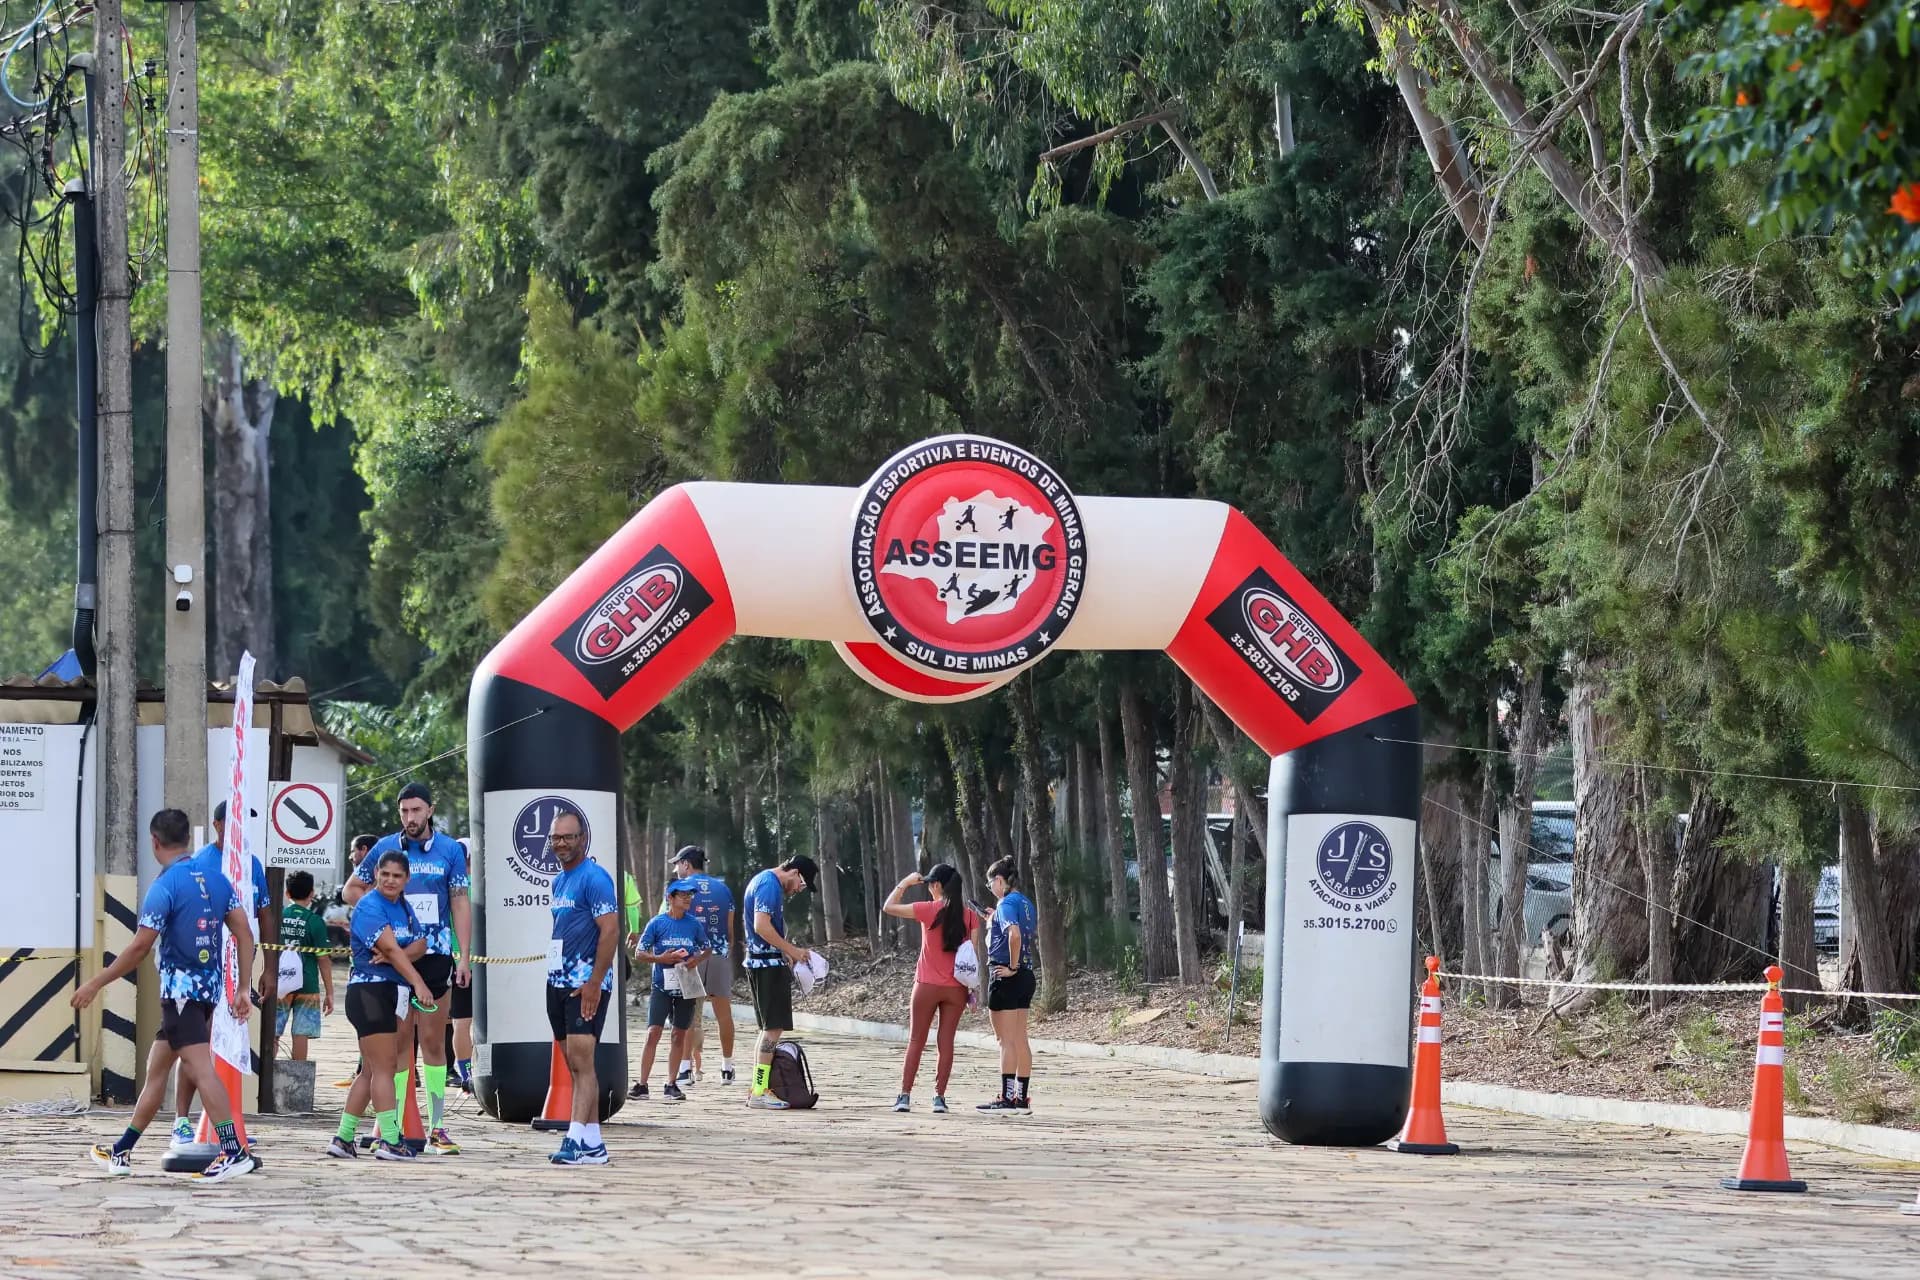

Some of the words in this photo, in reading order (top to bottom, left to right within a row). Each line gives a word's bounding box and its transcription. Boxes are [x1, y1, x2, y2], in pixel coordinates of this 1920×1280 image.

[956, 444, 966, 458] E
[971, 444, 1040, 477] EVENTOS
[876, 445, 953, 501] ESPORTIVA
[1038, 474, 1059, 497] DE
[1054, 495, 1082, 549] MINAS
[858, 505, 885, 617] ASSOCIAÇÃO
[883, 539, 1057, 571] ASSEEMG
[600, 585, 634, 618] GRUPO
[1056, 555, 1082, 620] GERAIS
[586, 574, 676, 657] GHB
[1288, 612, 1321, 645] GRUPO
[621, 608, 691, 677] 35.3851.2165
[905, 641, 940, 666] SUL
[943, 655, 968, 670] DE
[972, 646, 1029, 671] MINAS
[1249, 598, 1334, 686] GHB
[1230, 633, 1300, 702] 35.3851.2165
[3, 748, 22, 756] NOS
[270, 856, 331, 865] OBRIGATÓRIA
[277, 847, 326, 856] PASSAGEM
[520, 846, 563, 872] PARAFU
[1327, 830, 1346, 858] J
[1369, 843, 1386, 868] S
[506, 857, 550, 888] ATACADO
[1323, 870, 1385, 896] PARAFUSOS
[503, 894, 550, 907] 35.3015
[1309, 879, 1351, 912] ATACADO
[1354, 903, 1363, 912] &
[1364, 881, 1398, 911] VAREJO
[1303, 916, 1386, 931] 35.3015.2700
